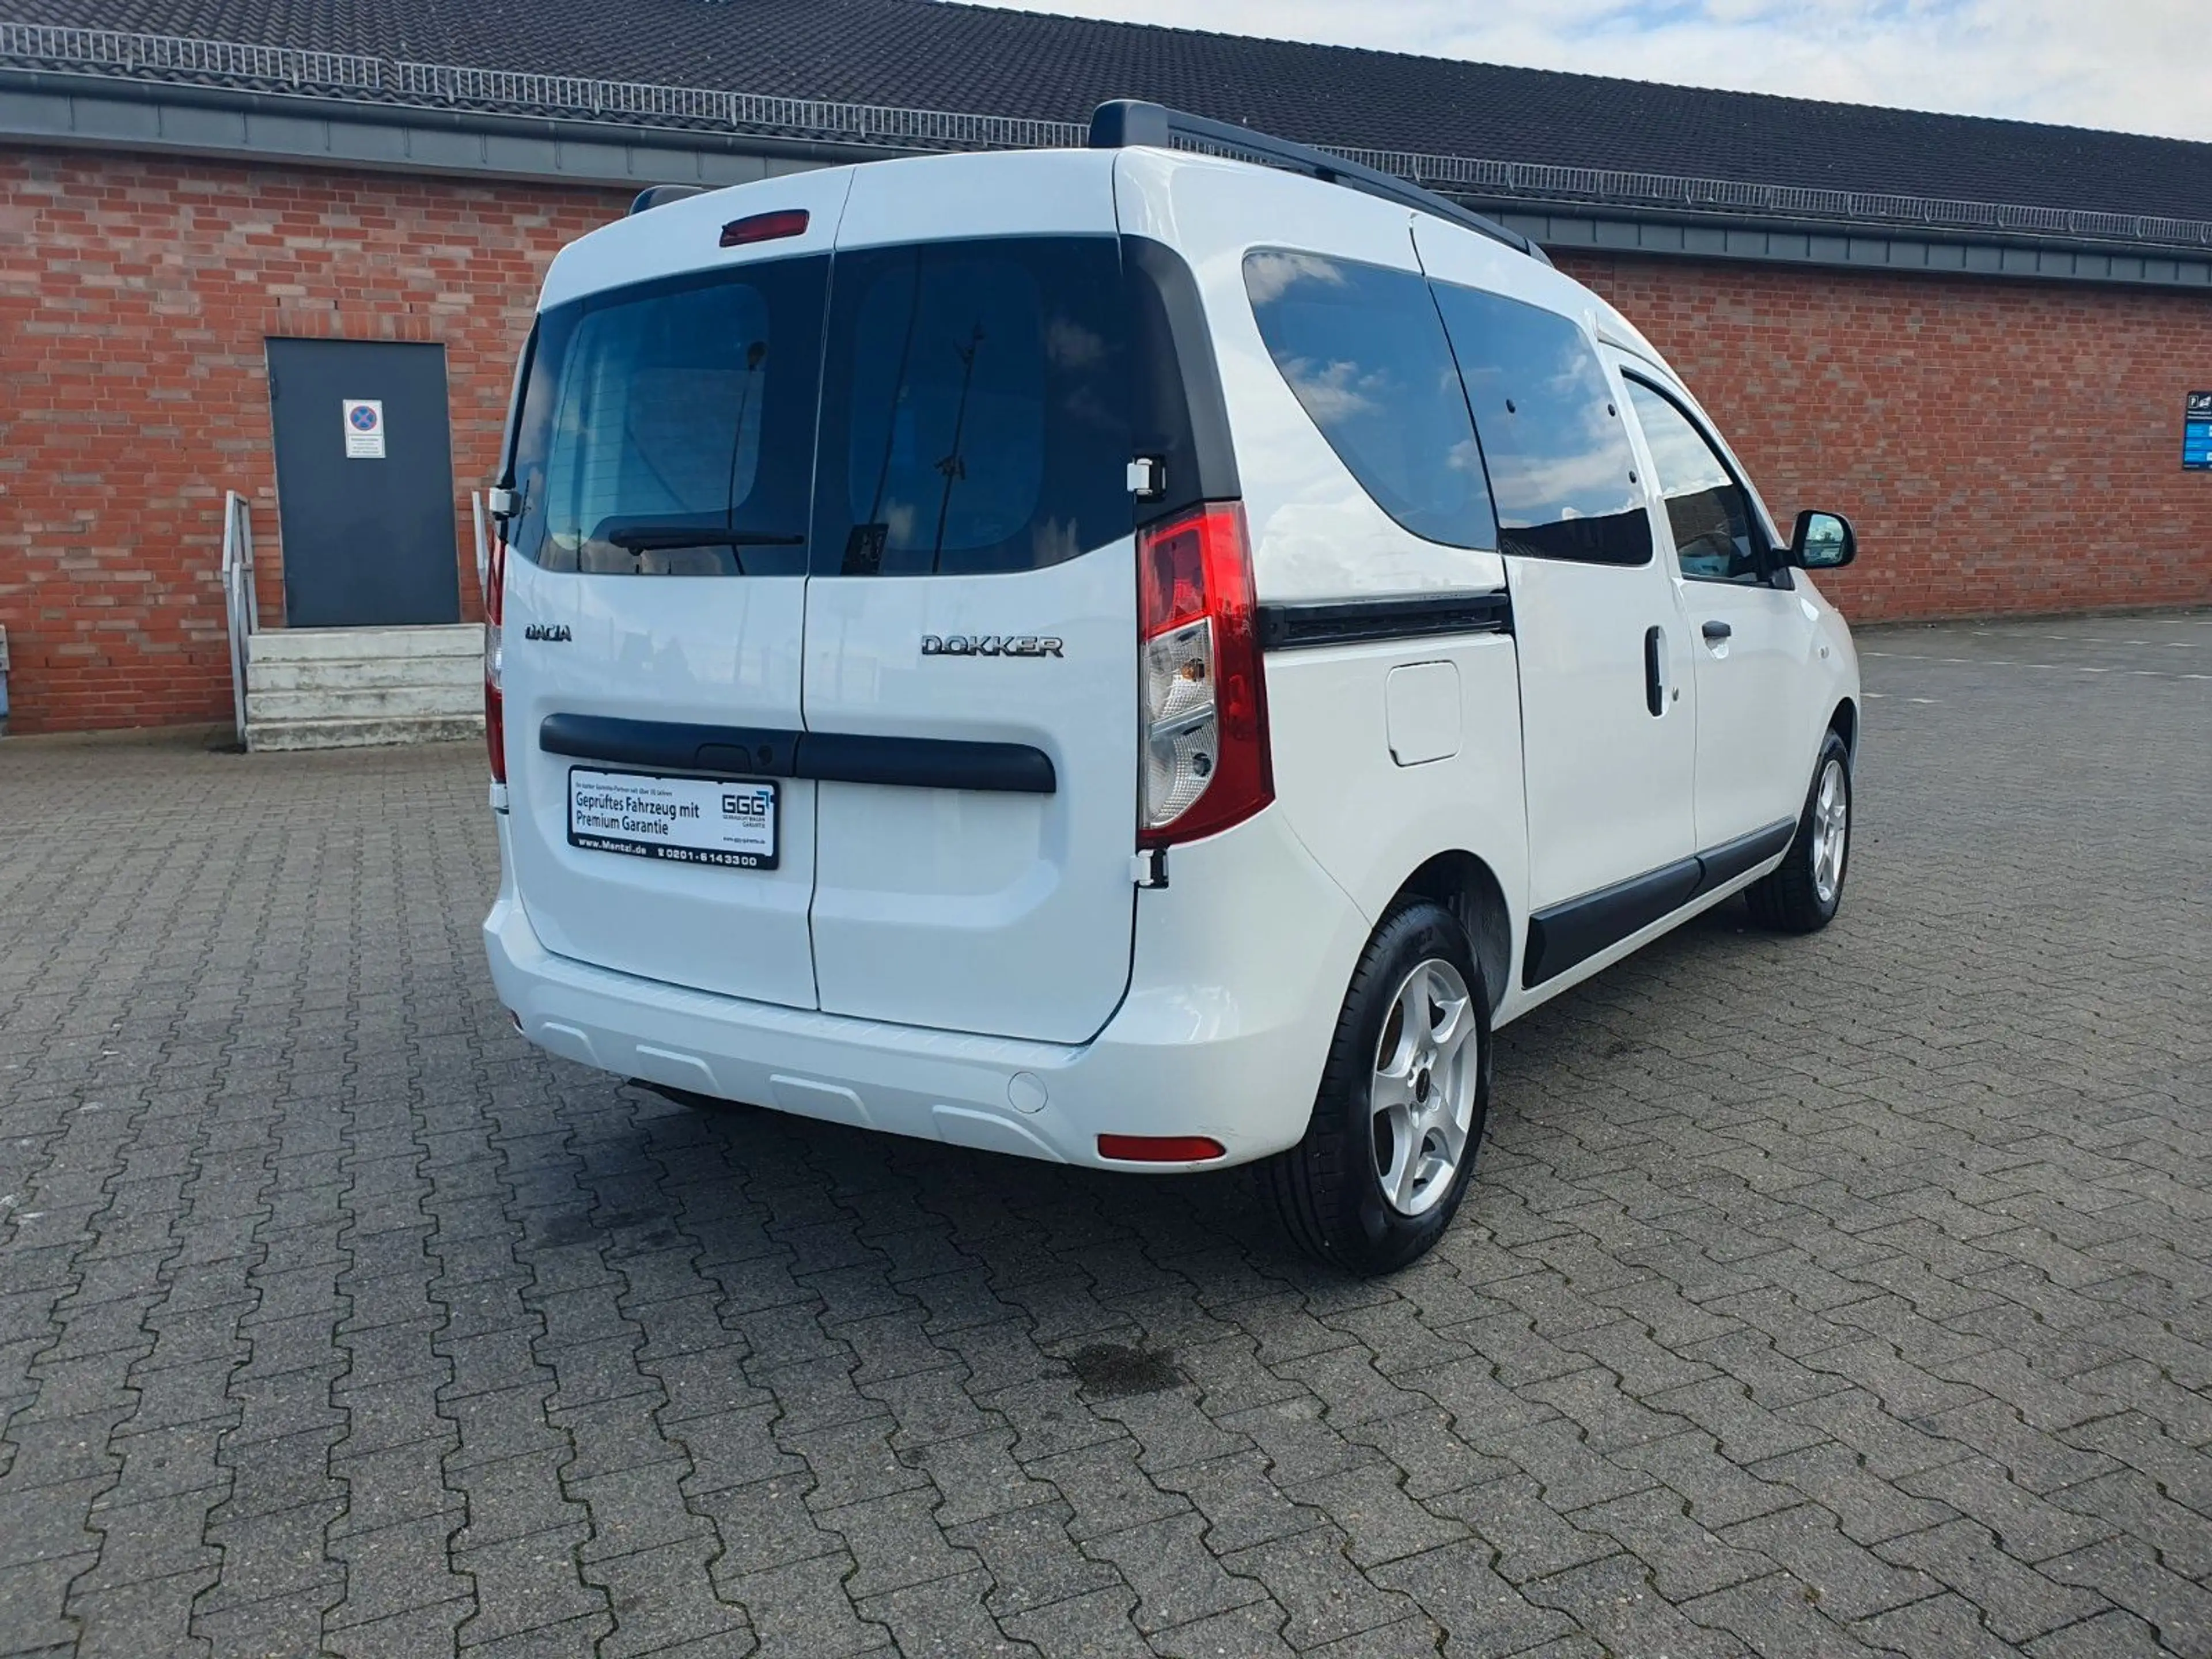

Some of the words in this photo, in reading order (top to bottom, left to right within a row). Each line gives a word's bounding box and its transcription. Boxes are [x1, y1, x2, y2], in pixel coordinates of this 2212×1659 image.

[525, 624, 572, 642] DACIA
[922, 635, 1064, 657] DOKKER
[576, 792, 623, 811] Geprüftes
[626, 796, 676, 820] Fahrzeug
[680, 802, 699, 819] mit
[722, 794, 765, 816] GGG
[576, 810, 620, 830] Premium
[622, 816, 669, 835] Garantie
